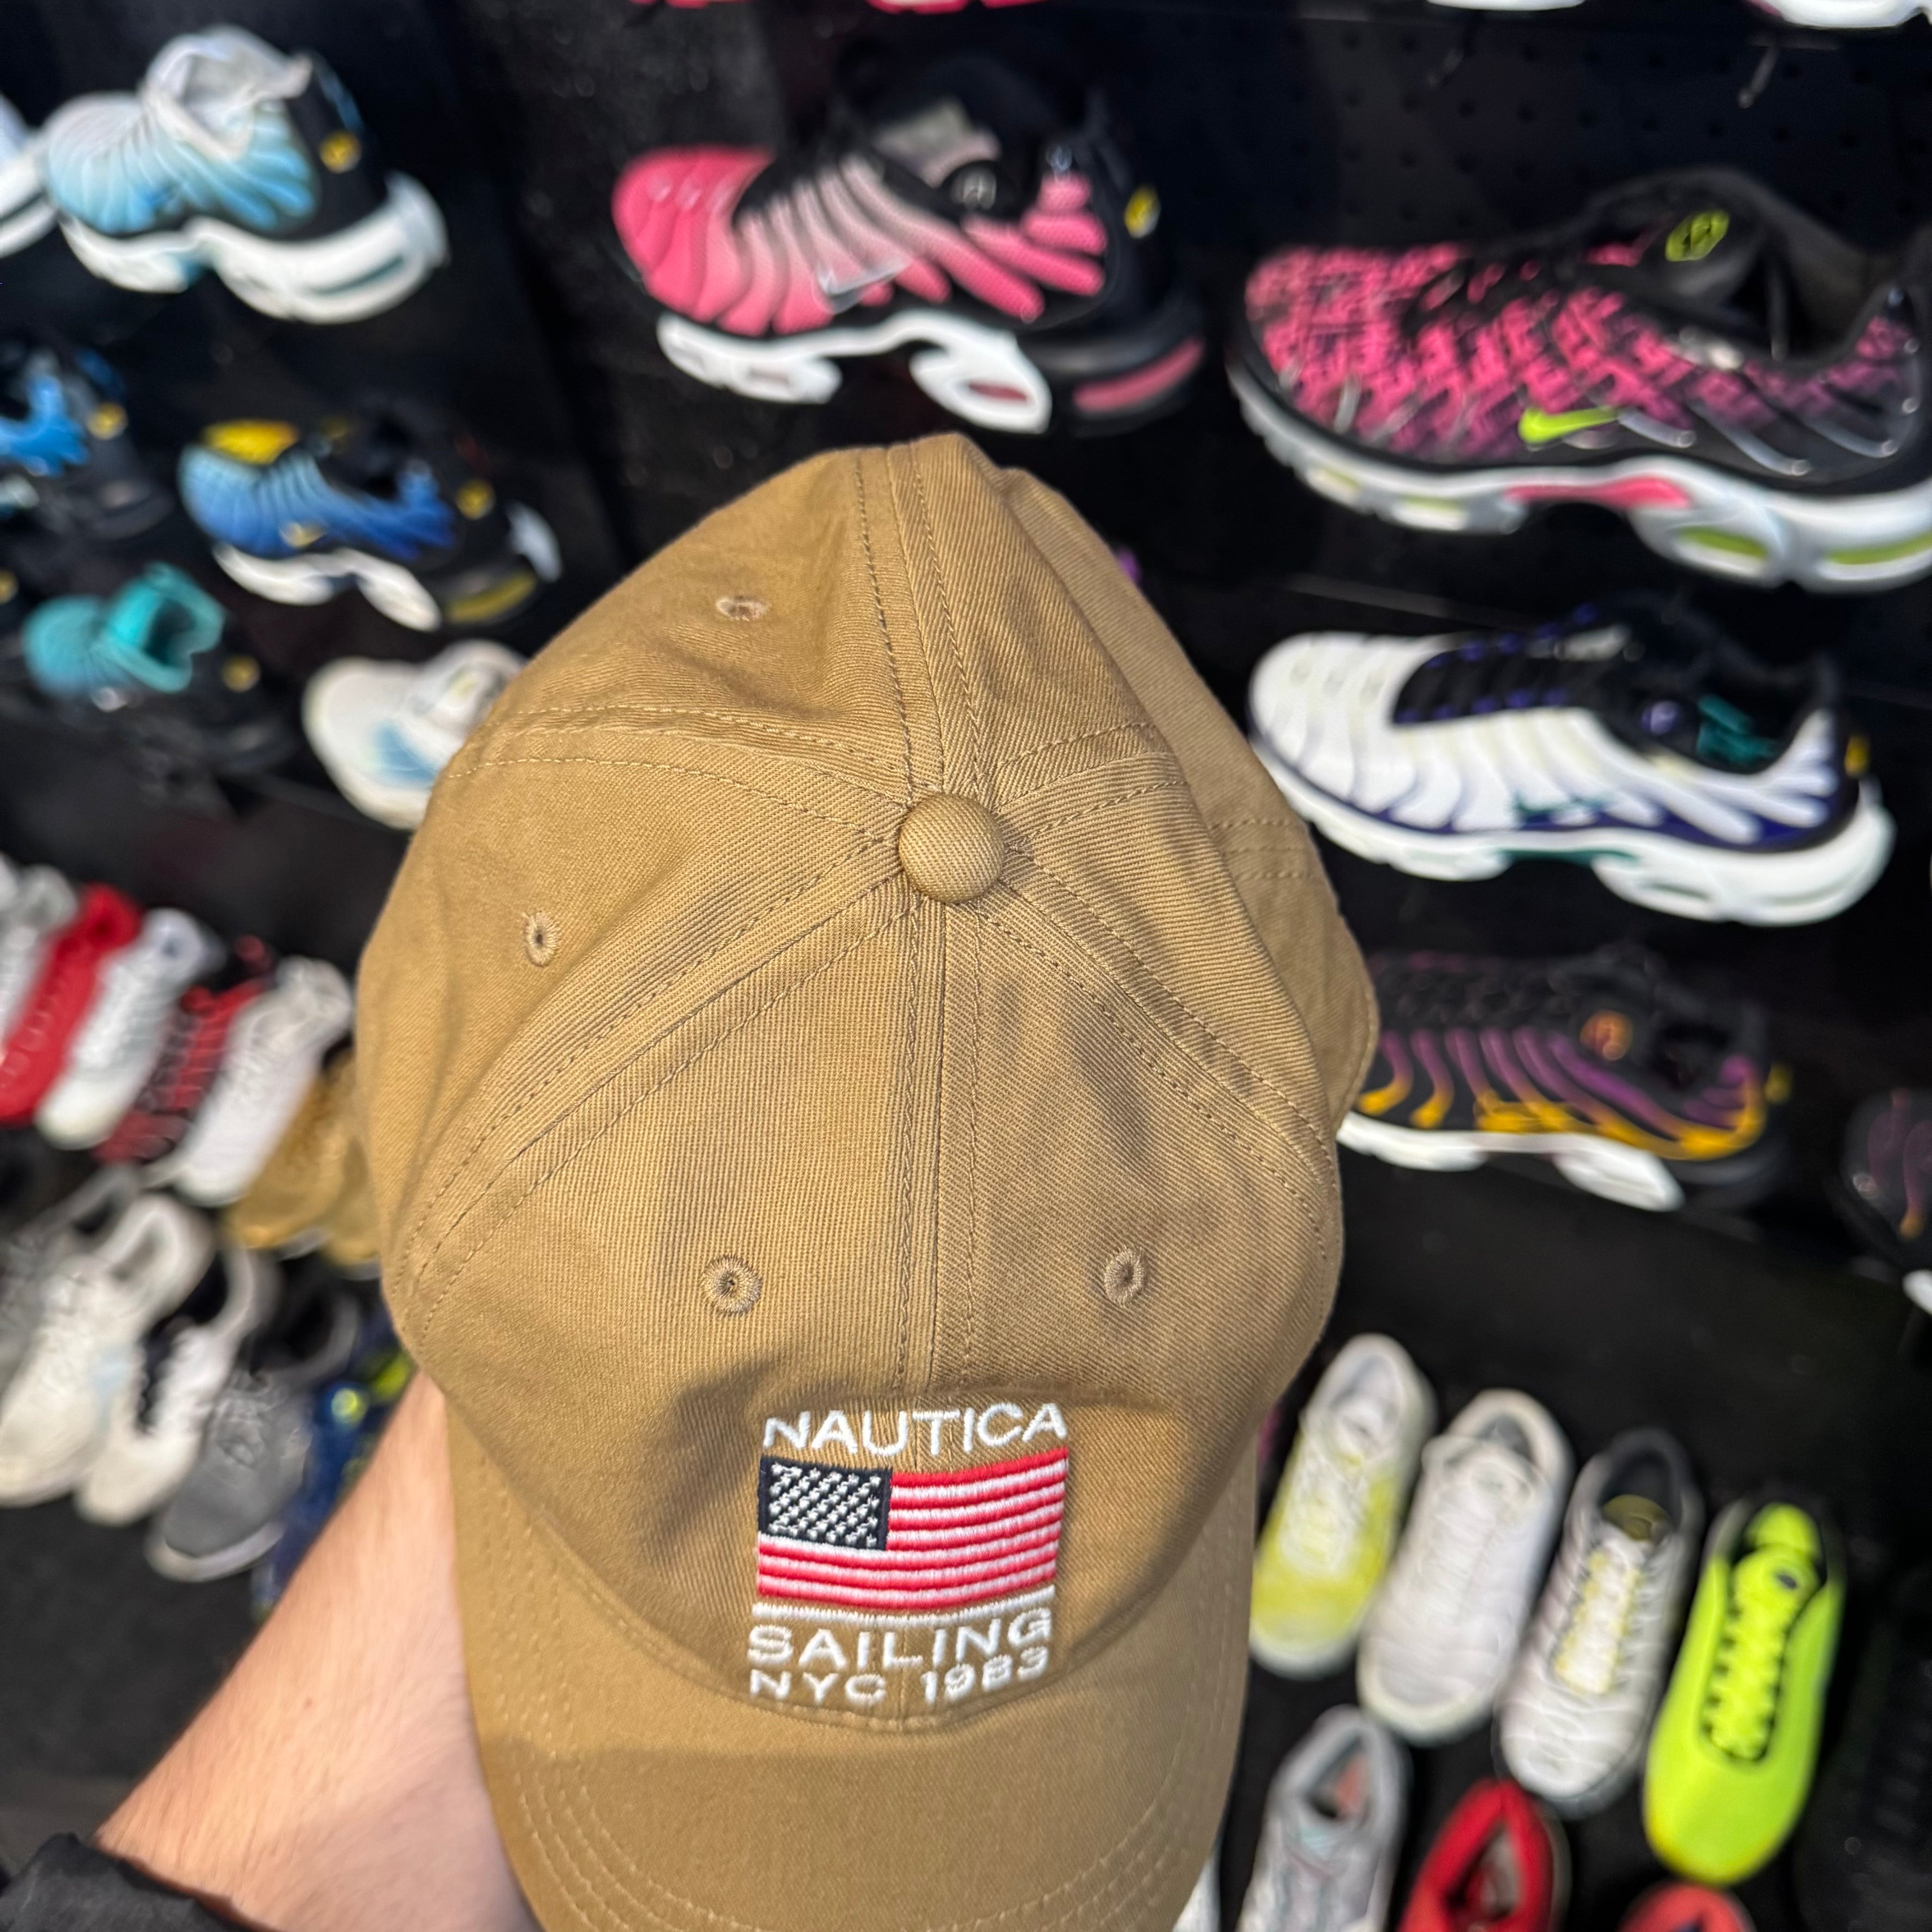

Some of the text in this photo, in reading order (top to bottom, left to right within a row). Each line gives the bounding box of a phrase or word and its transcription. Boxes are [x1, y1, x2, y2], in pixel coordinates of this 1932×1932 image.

[763, 1403, 1068, 1457] NAUTICA
[747, 1607, 1052, 1670] SAILING
[749, 1646, 1049, 1706] NYC 1983
